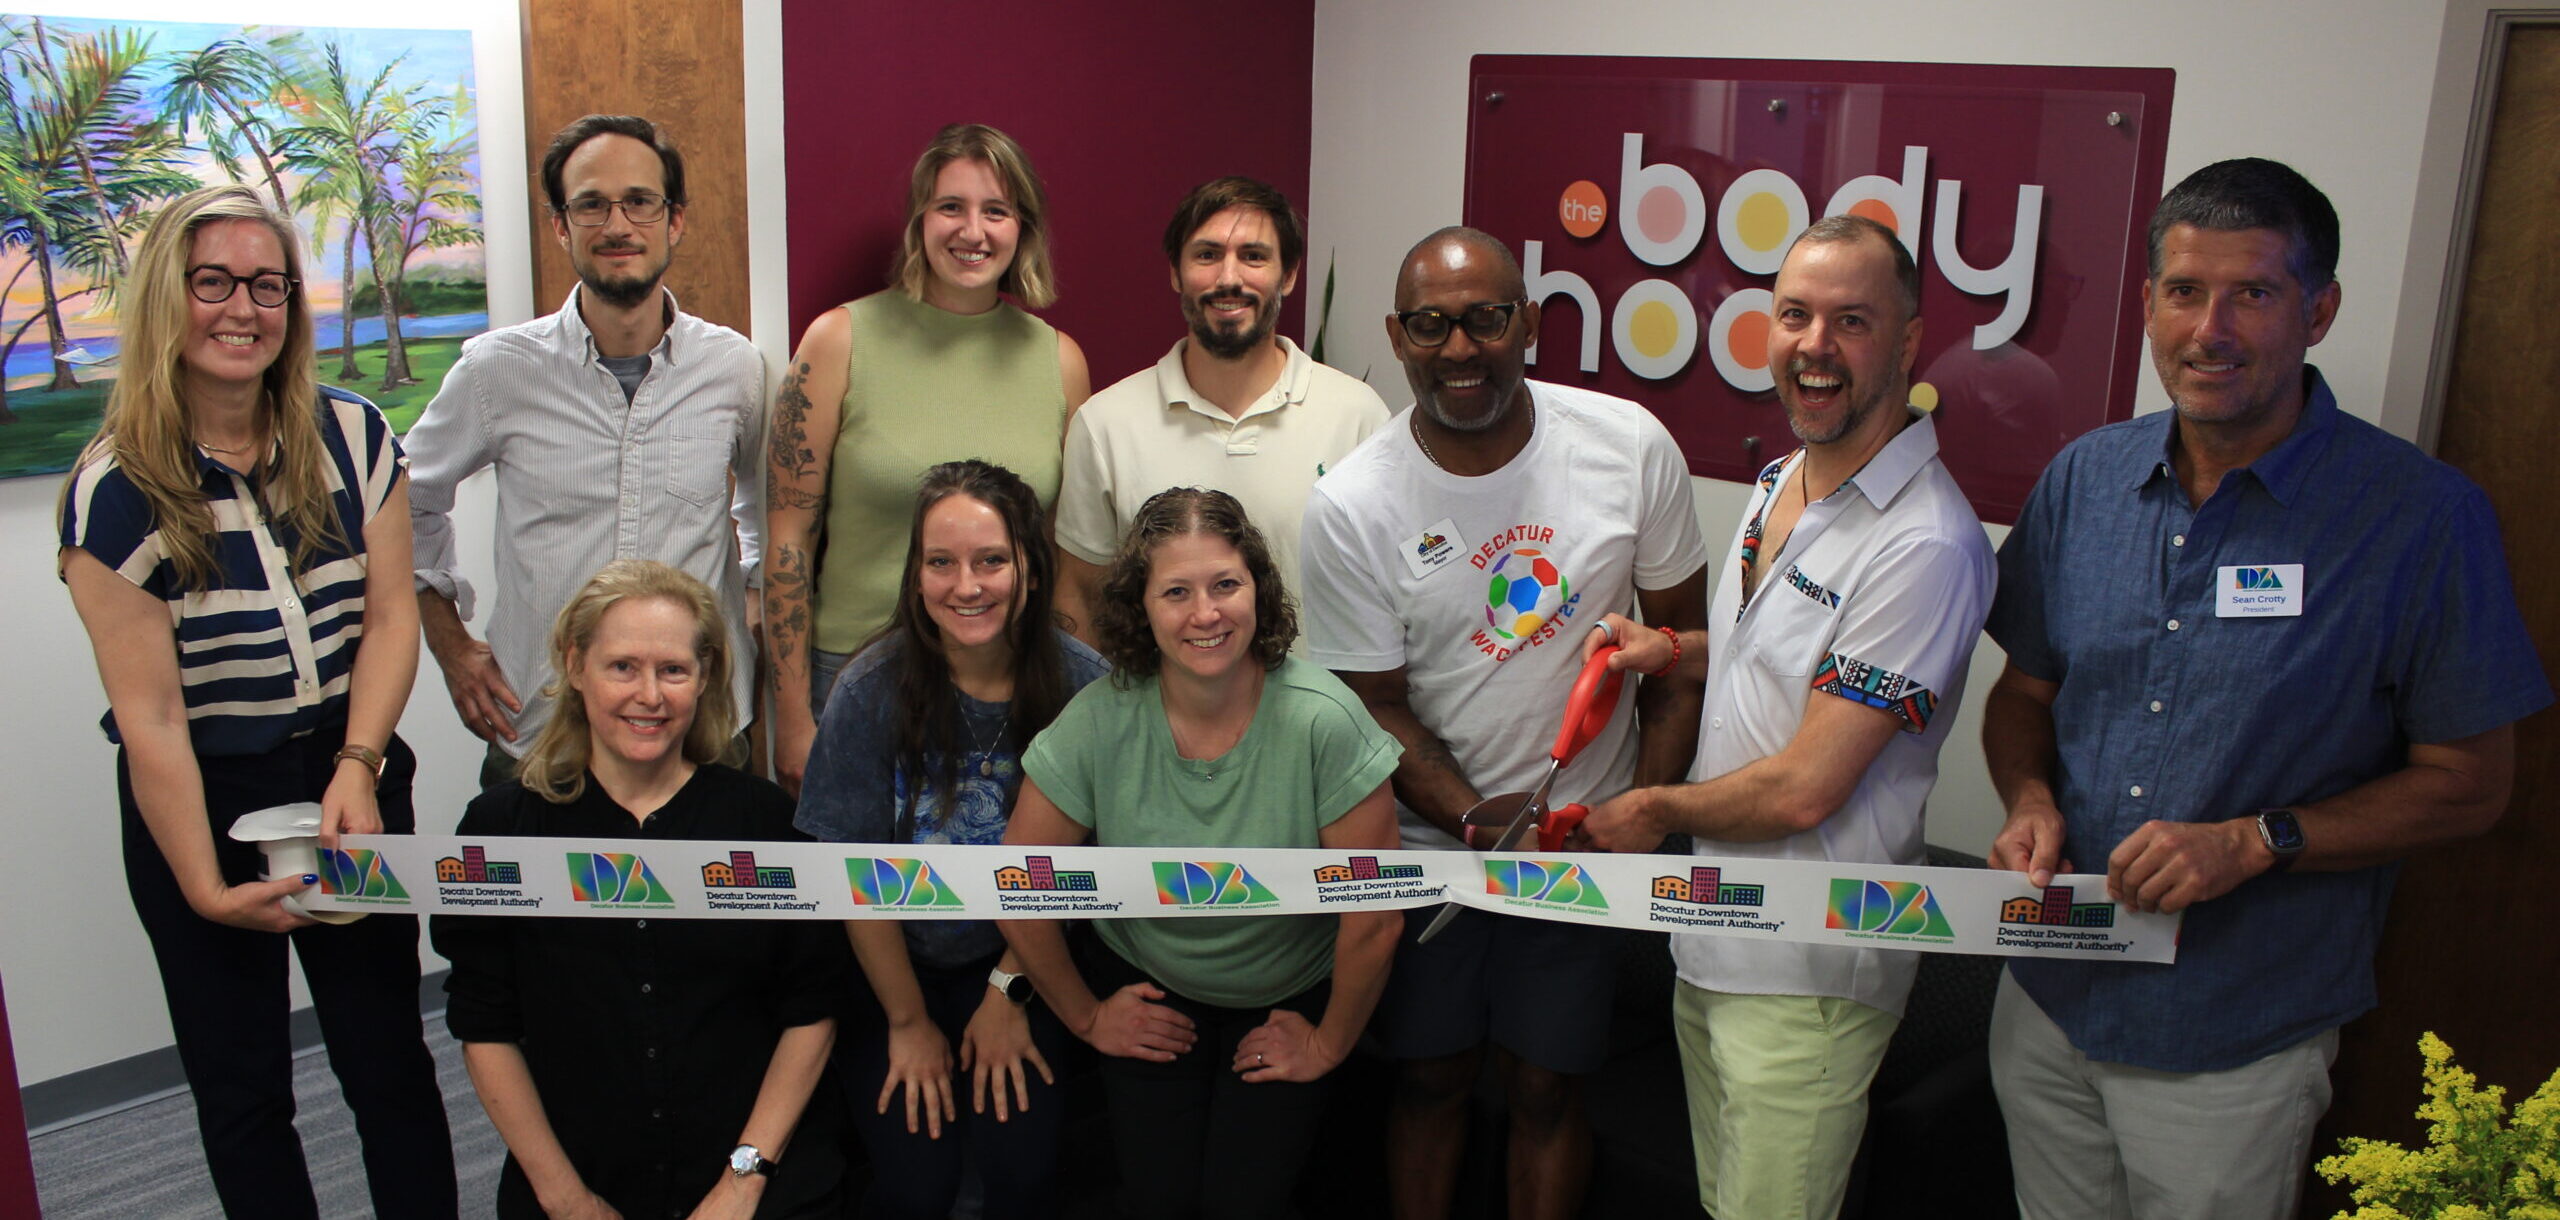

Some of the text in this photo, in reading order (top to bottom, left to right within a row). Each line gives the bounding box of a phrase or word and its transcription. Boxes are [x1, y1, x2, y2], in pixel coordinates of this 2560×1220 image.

[1563, 132, 2045, 351] the body
[1523, 239, 1776, 393] hoo
[1470, 524, 1555, 570] DECATUR
[2232, 595, 2287, 605] Sean Crotty
[439, 887, 523, 897] Decatur Downtown
[1317, 880, 1423, 893] Decatur Downtown
[441, 897, 498, 907] Development
[706, 892, 797, 900] Decatur Downtown
[999, 894, 1041, 902] Decatur
[1319, 890, 1391, 903] Development
[708, 901, 771, 911] Development
[1001, 903, 1069, 912] Development
[1504, 898, 1609, 916] Decatur Business Association
[1650, 902, 1760, 919] Decatur Downtown
[1649, 912, 1725, 927] Development
[1998, 927, 2109, 940] Decatur Downtown
[1996, 937, 2074, 949] Development
